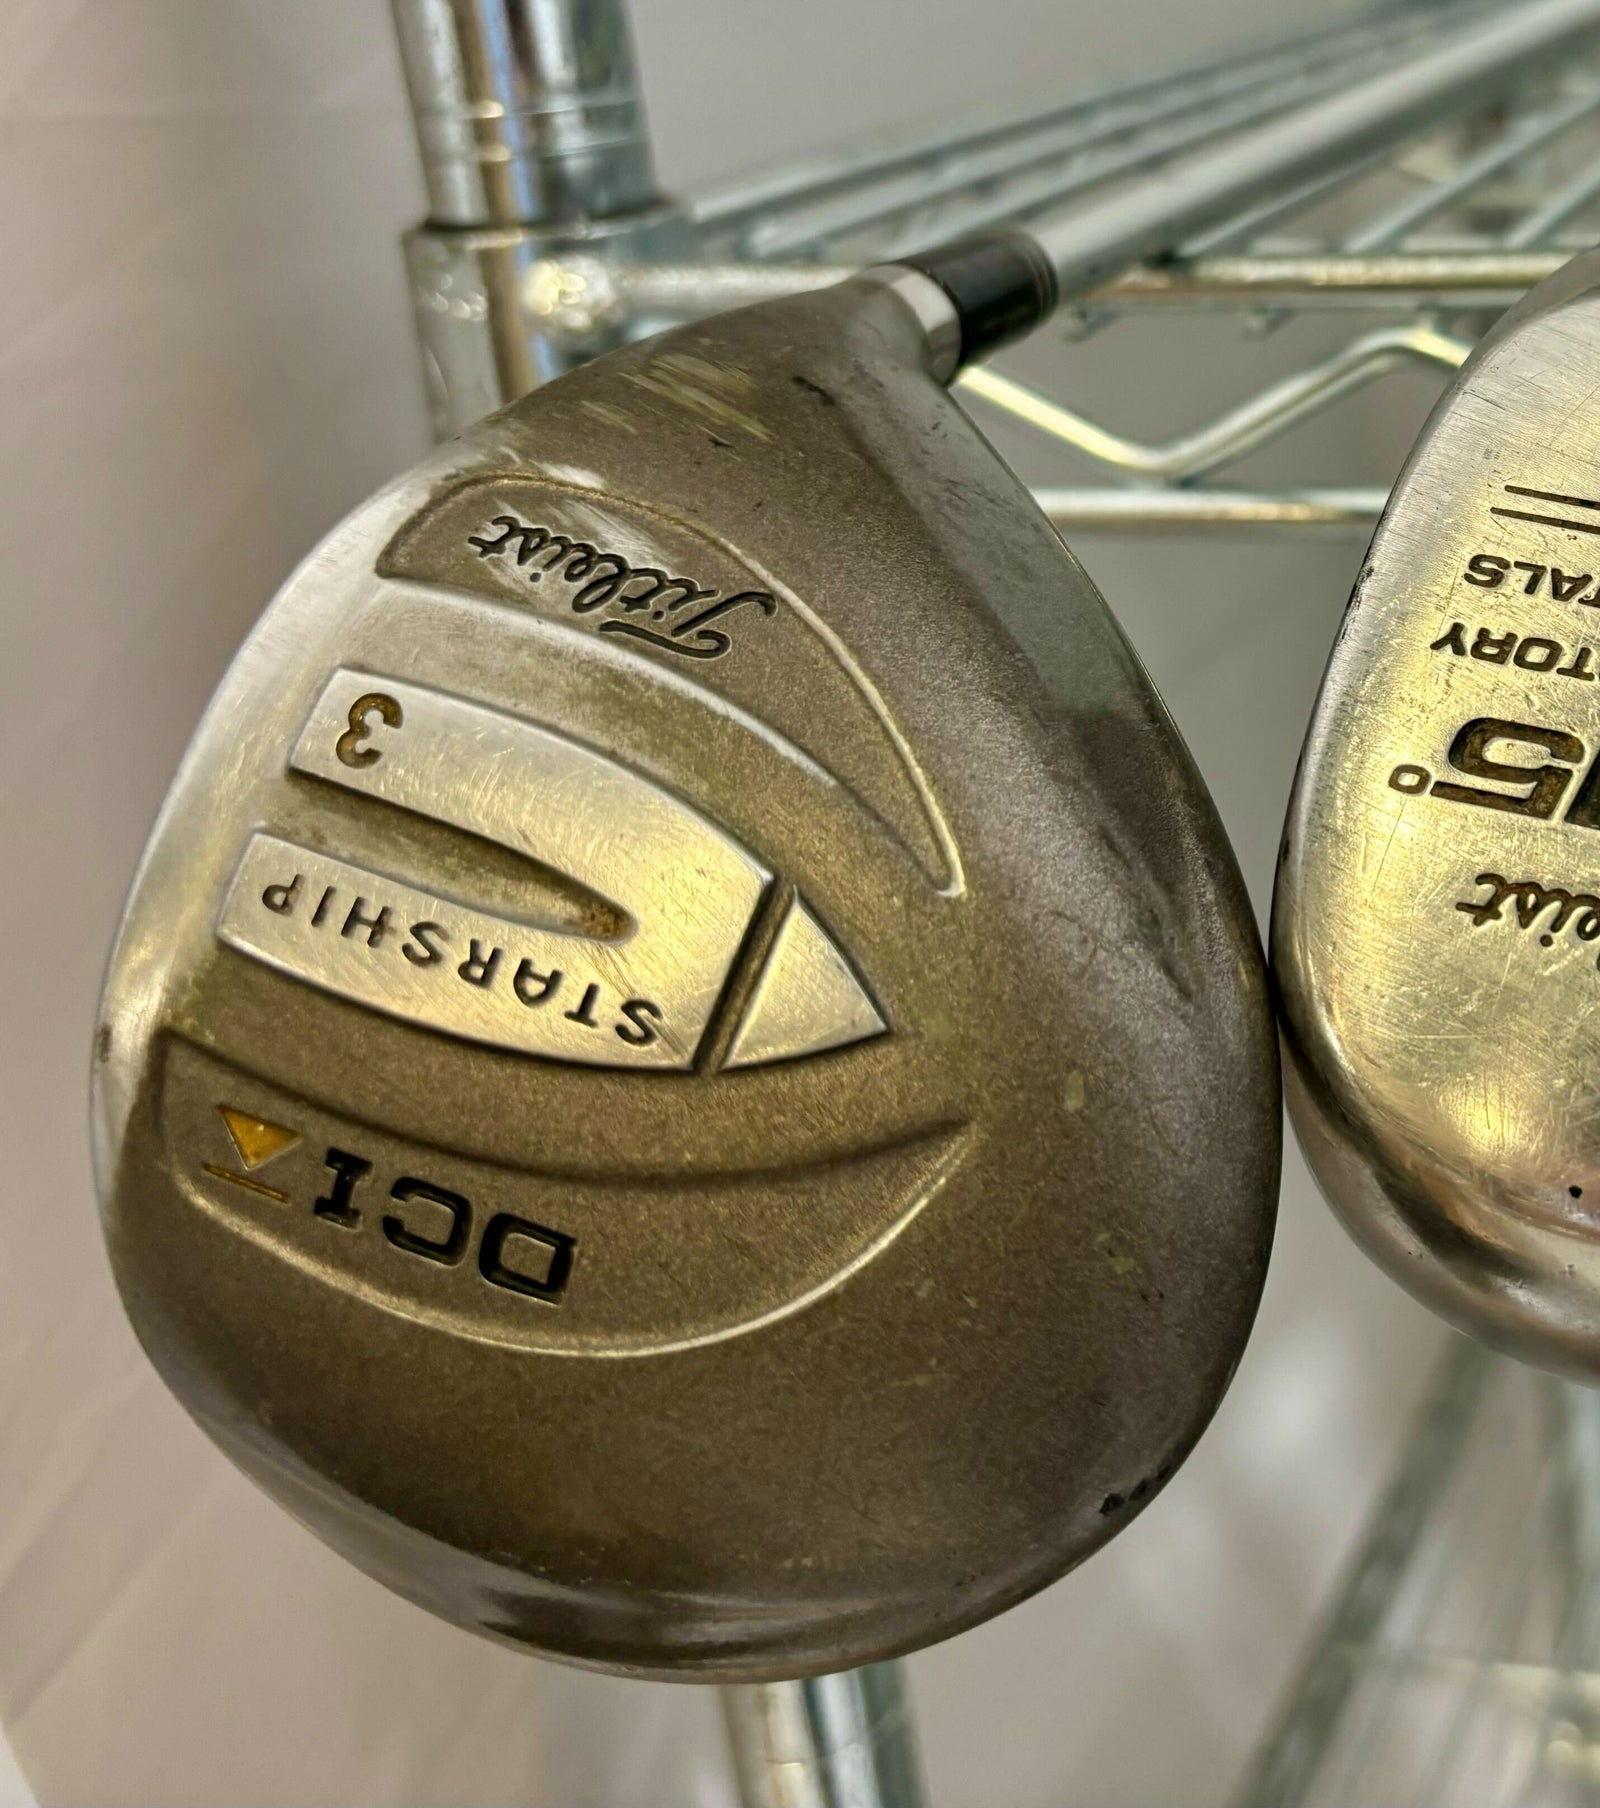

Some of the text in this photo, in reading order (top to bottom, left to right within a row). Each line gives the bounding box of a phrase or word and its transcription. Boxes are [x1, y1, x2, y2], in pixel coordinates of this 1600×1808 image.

[466, 515, 777, 658] Titleist
[335, 692, 404, 769] 3
[261, 873, 663, 1046] STARSHIP
[313, 1147, 579, 1305] DCI
